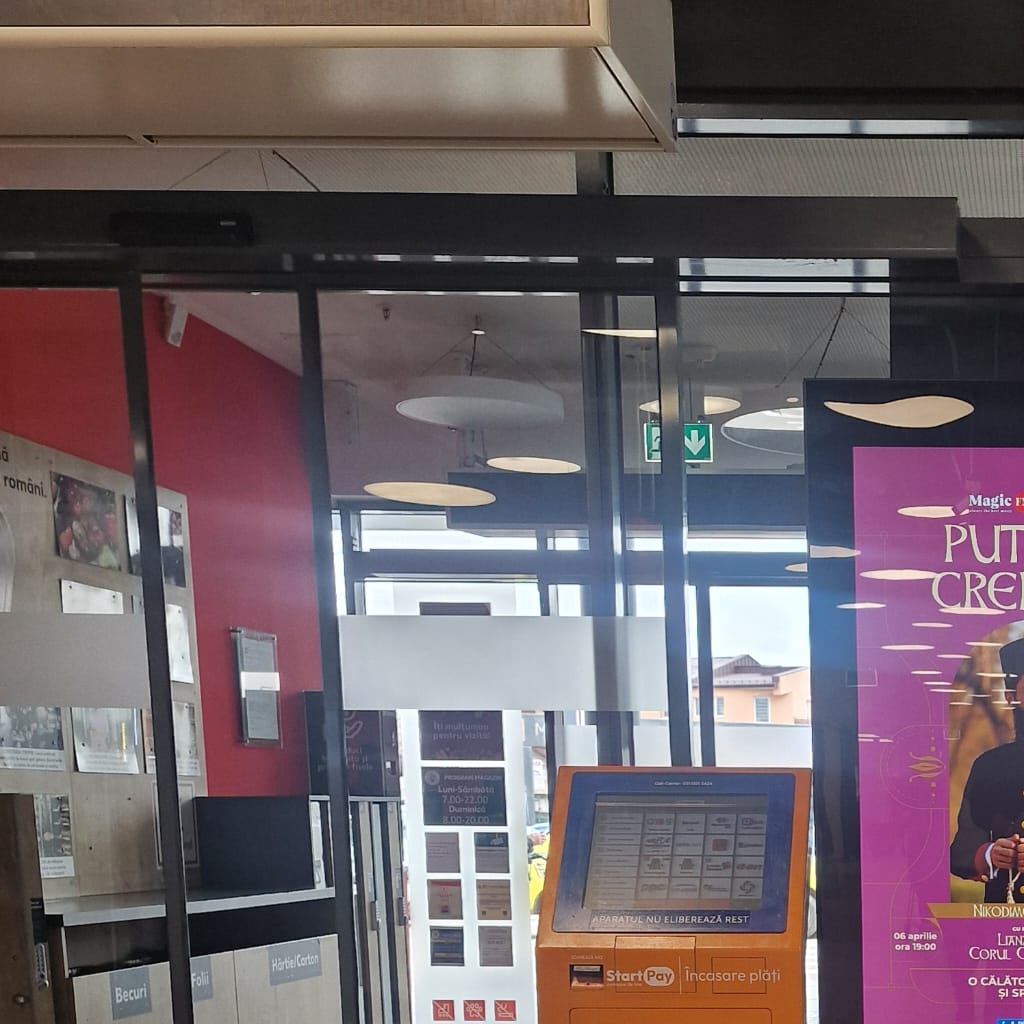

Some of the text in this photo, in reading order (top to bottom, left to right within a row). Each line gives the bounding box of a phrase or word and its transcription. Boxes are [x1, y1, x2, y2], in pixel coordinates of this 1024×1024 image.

[4, 475, 47, 498] români.
[969, 494, 1012, 509] Magic
[592, 914, 750, 924] APARATUL NU ELIBEREAZĂ REST
[893, 932, 937, 941] 06 aprilie
[685, 966, 746, 982] Încasare
[750, 968, 781, 984] plăți
[968, 977, 977, 986] O
[115, 984, 148, 1004] Becuri
[998, 988, 1009, 1000] ȘI
